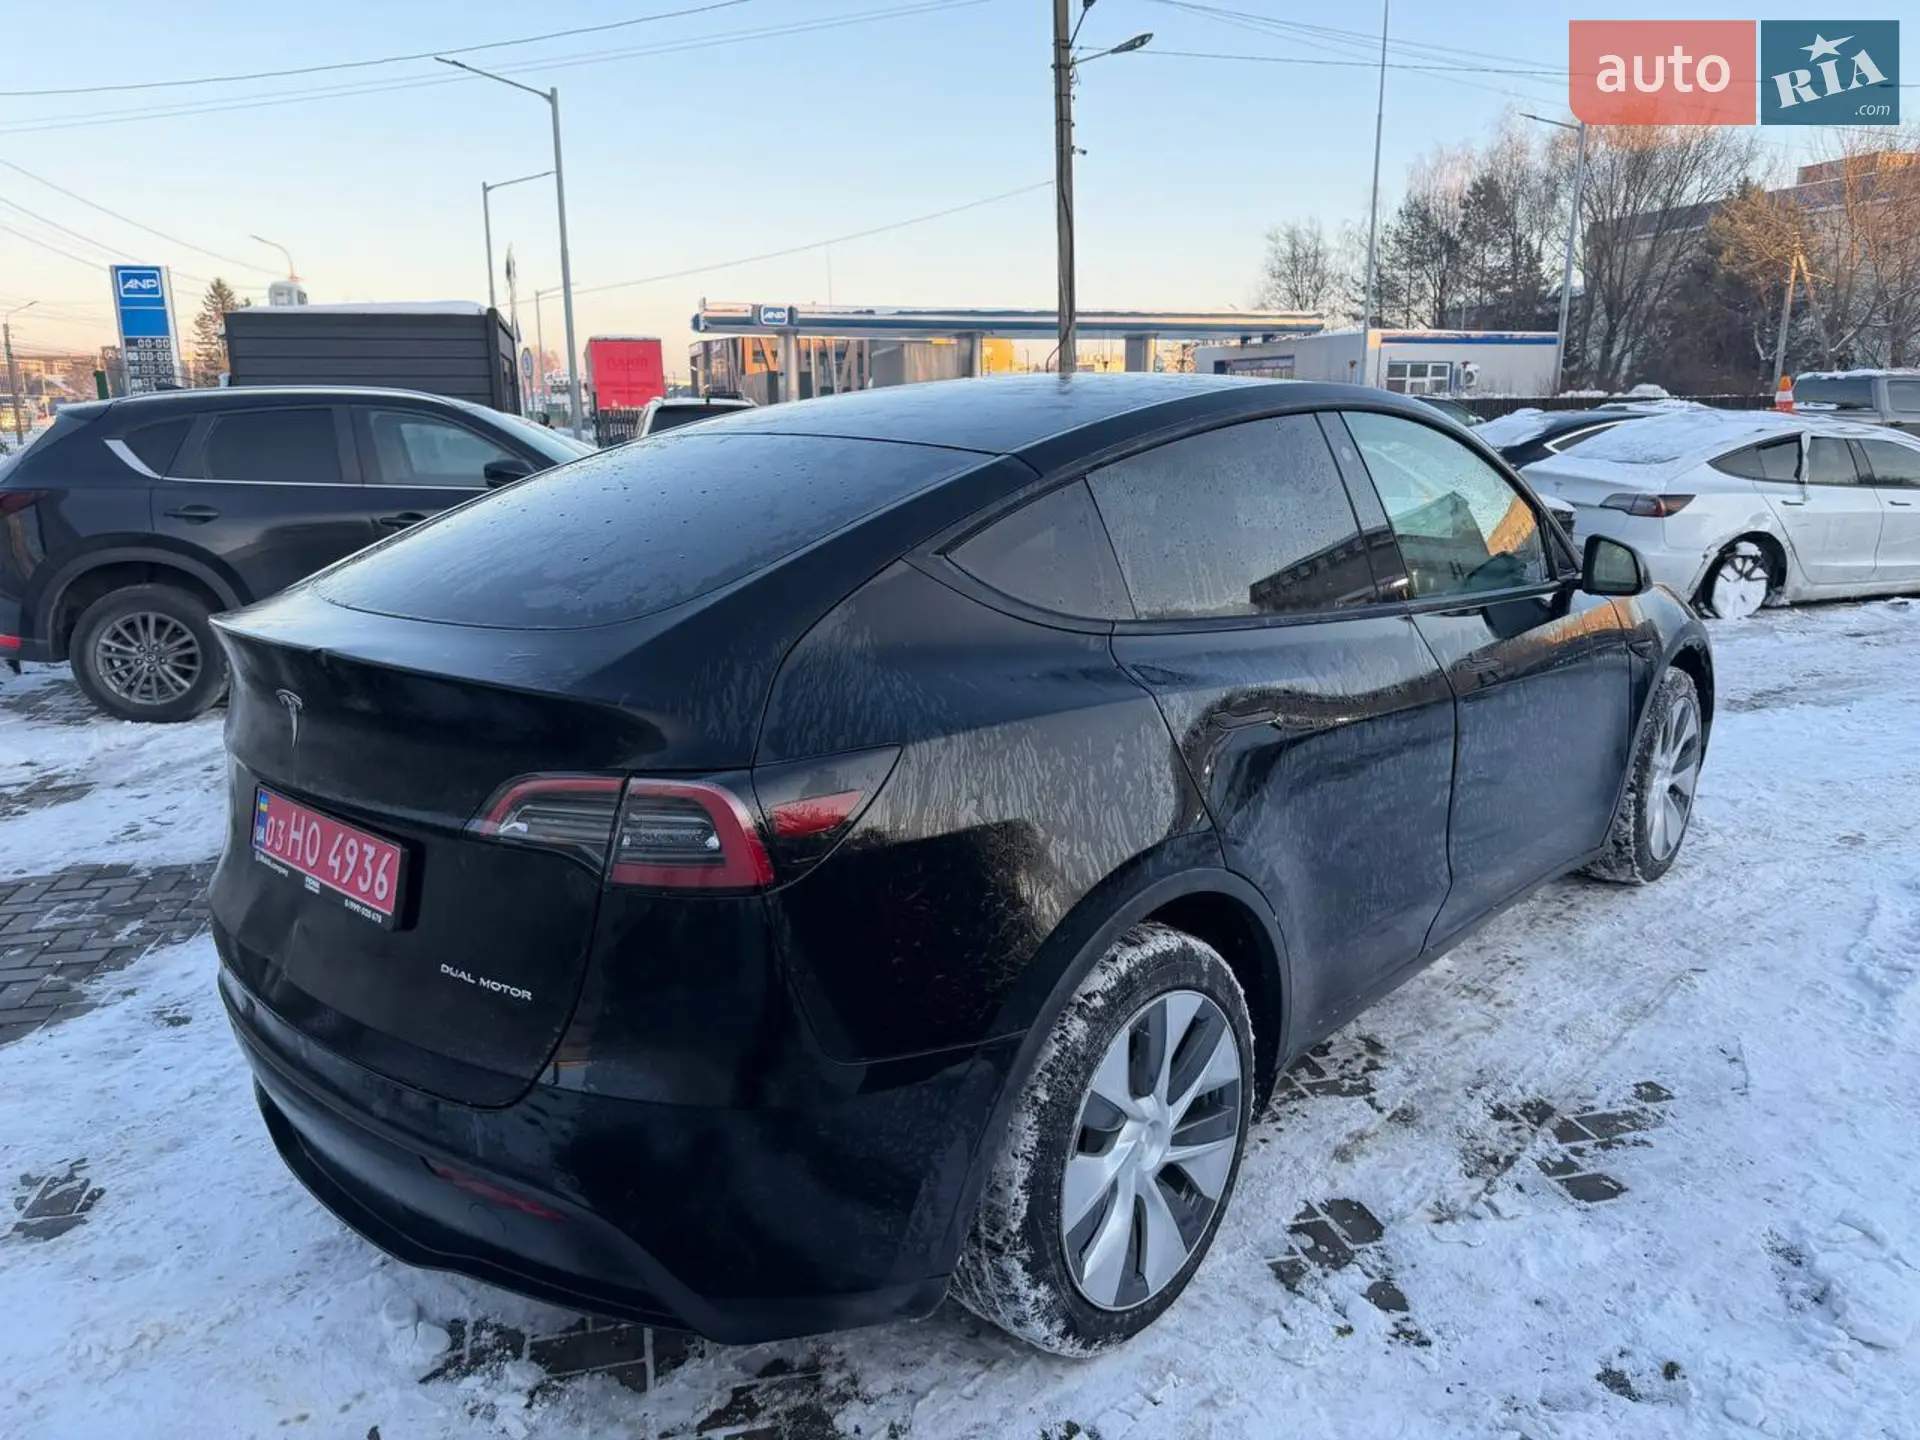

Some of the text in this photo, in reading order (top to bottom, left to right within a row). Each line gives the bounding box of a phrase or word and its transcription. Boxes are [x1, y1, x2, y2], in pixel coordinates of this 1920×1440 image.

[123, 278, 158, 289] ANP
[328, 832, 392, 901] 4936
[440, 963, 532, 1001] DUAL MOTOR
